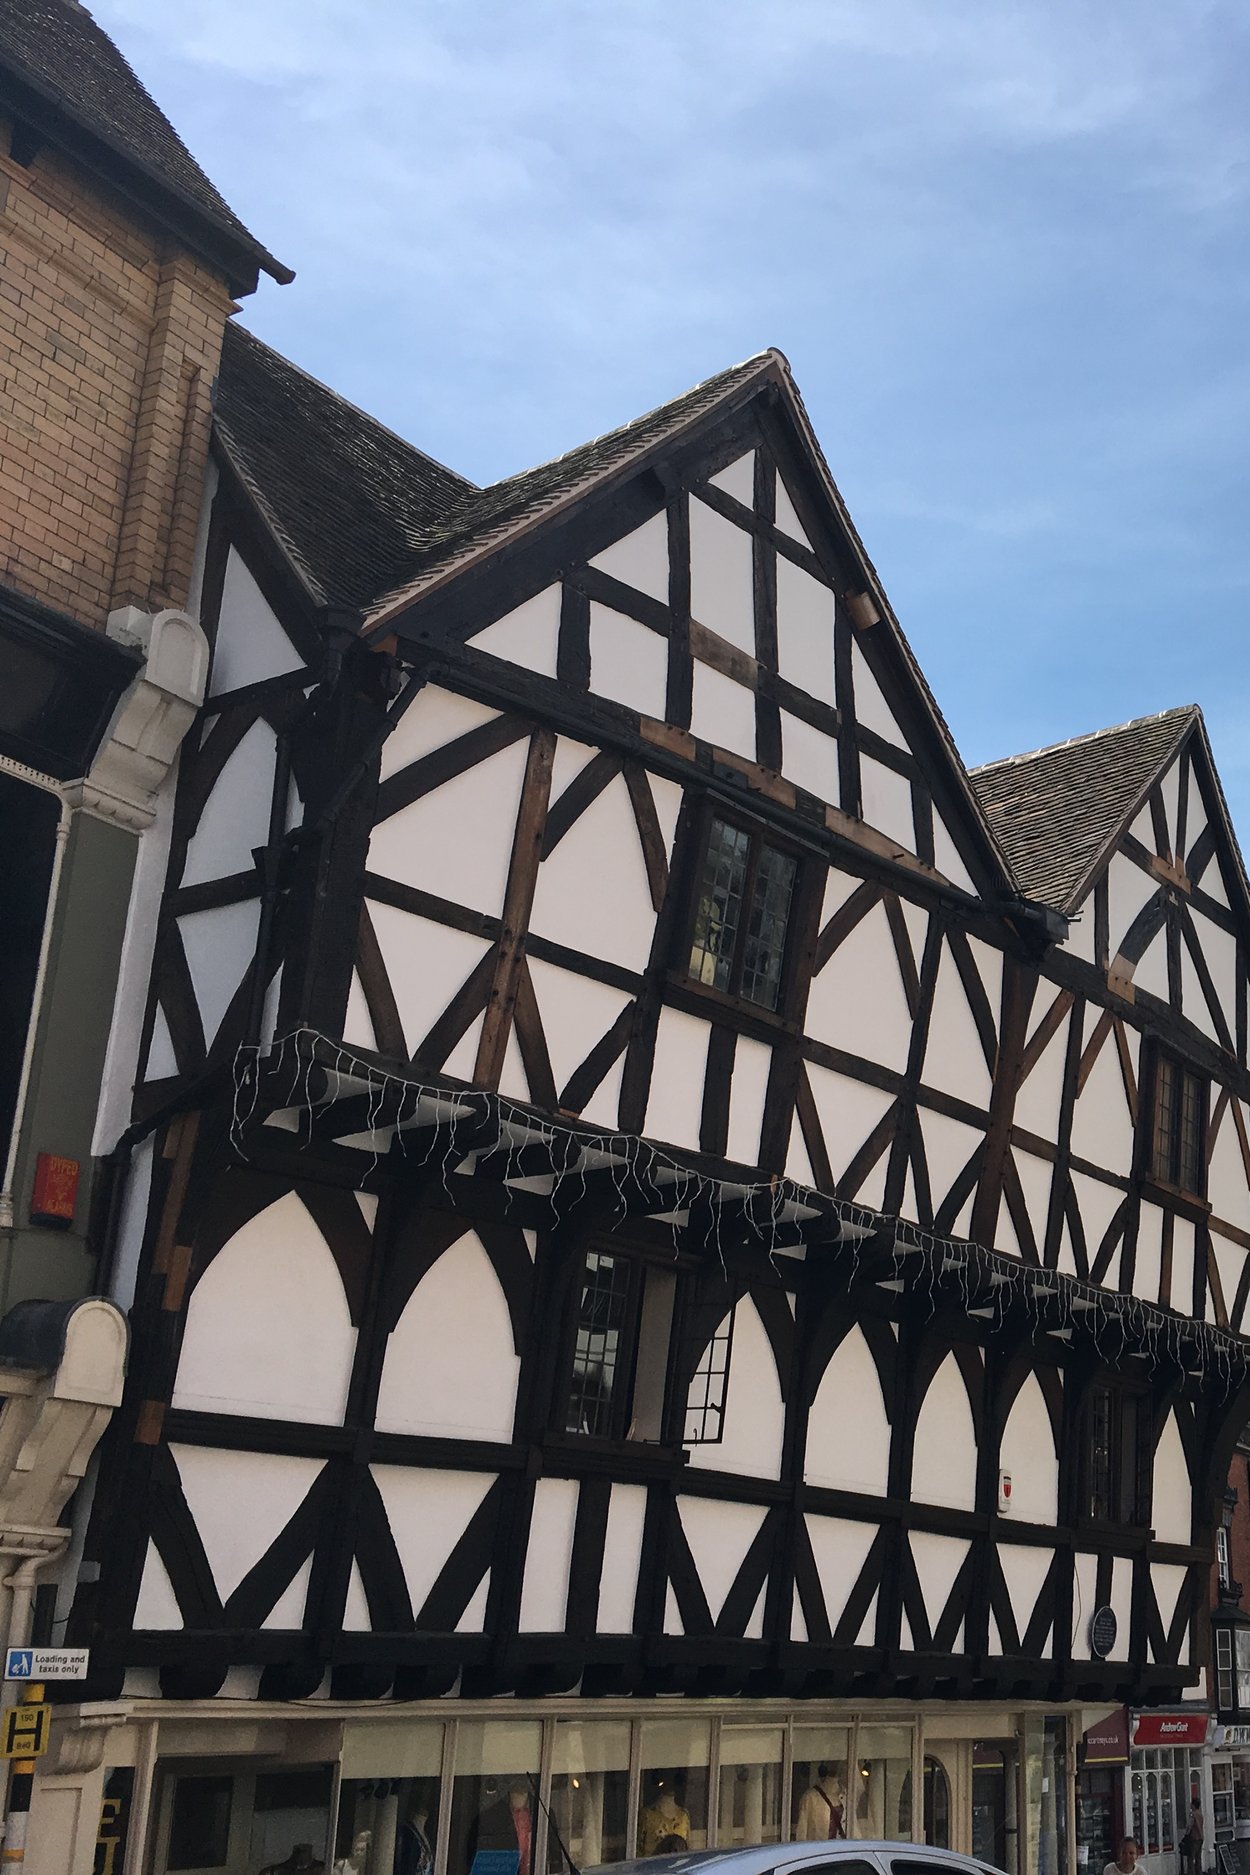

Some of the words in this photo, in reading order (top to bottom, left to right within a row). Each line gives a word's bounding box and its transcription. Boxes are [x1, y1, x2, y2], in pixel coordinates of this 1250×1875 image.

[35, 1655, 67, 1664] Loading
[70, 1655, 85, 1663] and
[39, 1665, 58, 1673] taxis
[62, 1665, 79, 1674] only
